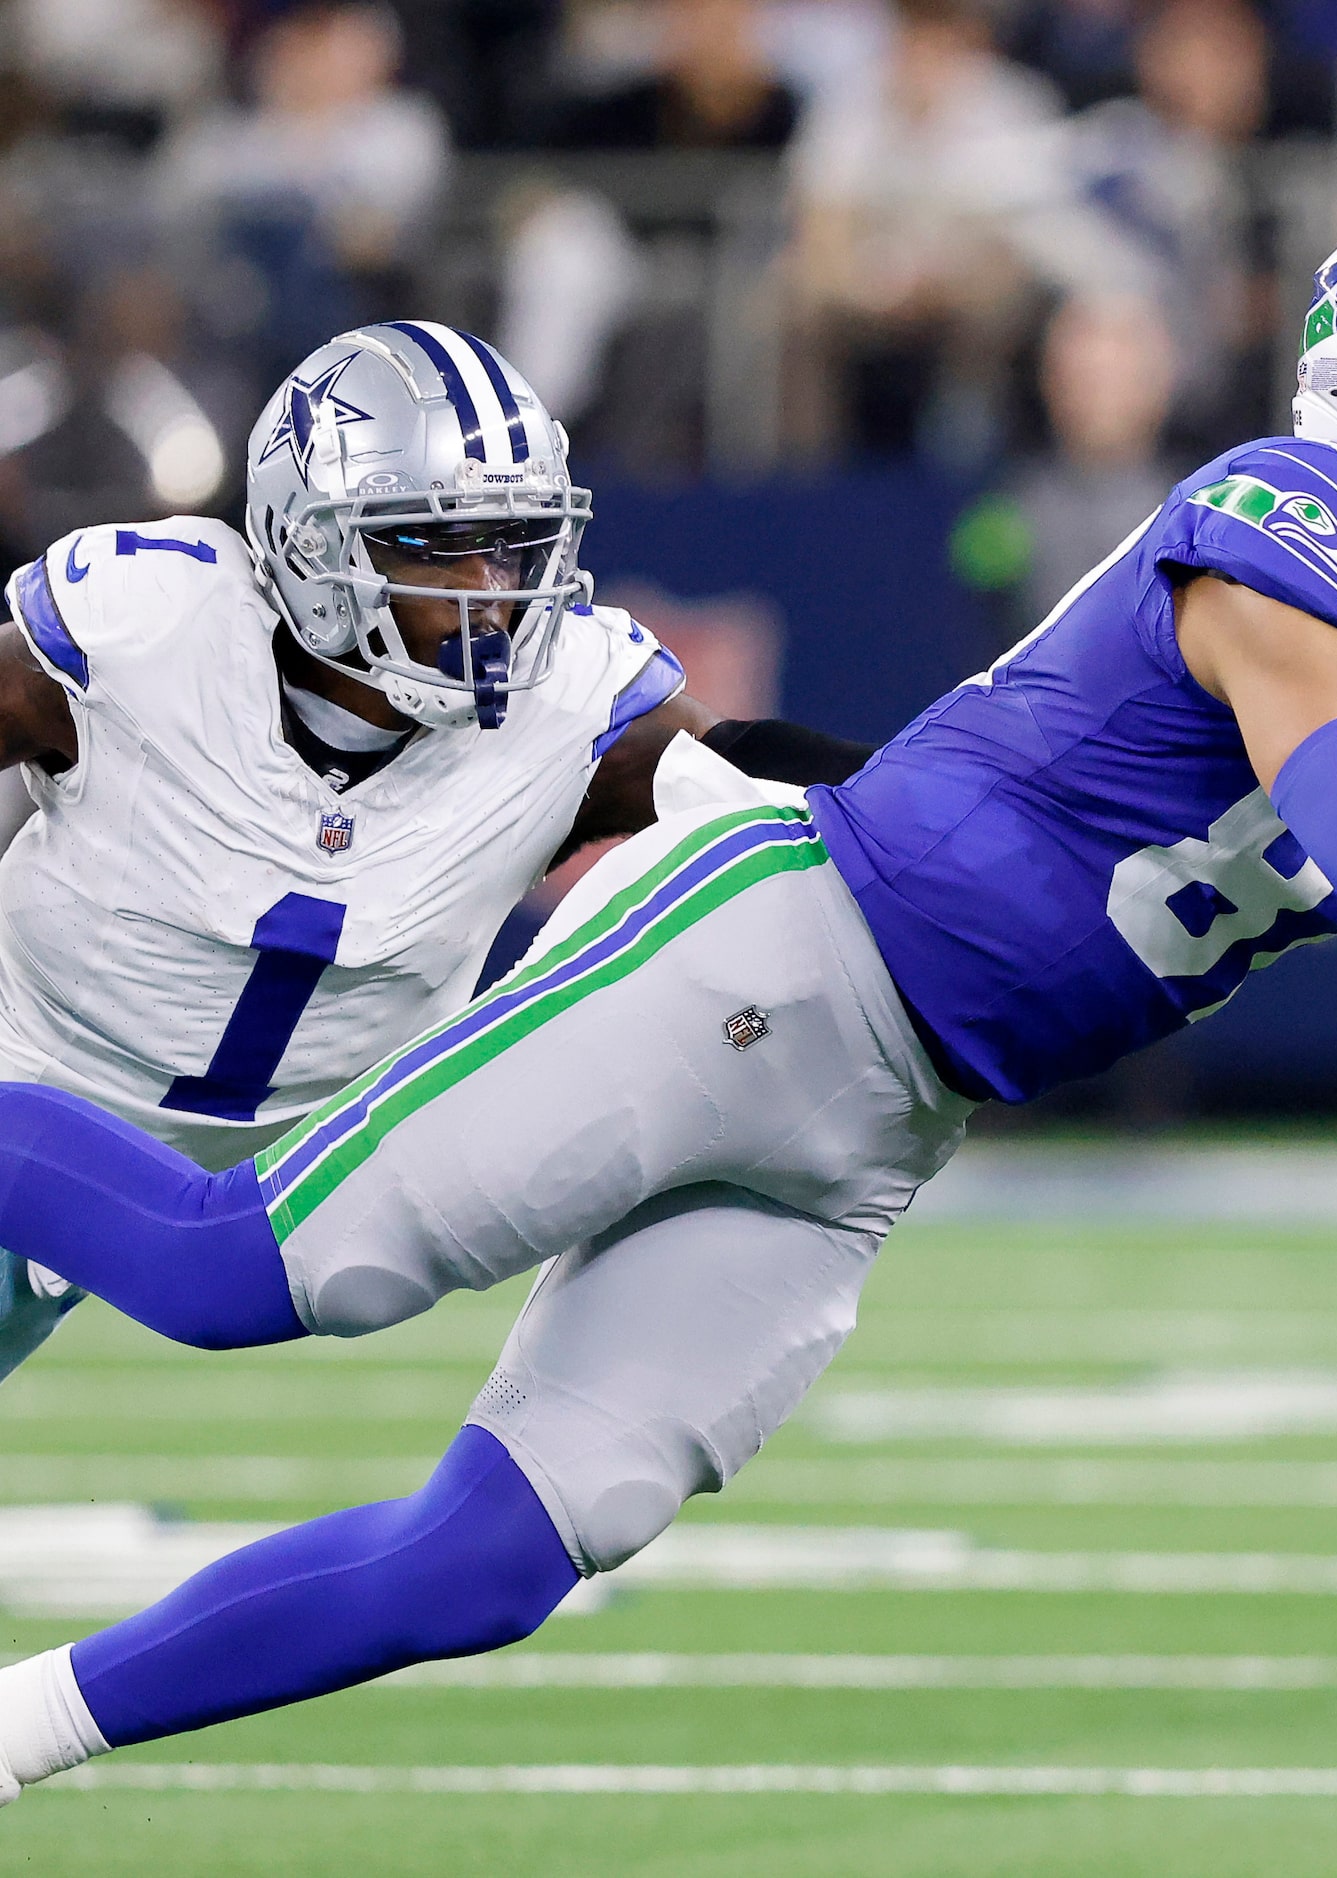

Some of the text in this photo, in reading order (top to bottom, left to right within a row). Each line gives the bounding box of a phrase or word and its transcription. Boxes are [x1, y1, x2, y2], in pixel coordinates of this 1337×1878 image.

[360, 485, 407, 495] OAKLEY
[115, 530, 217, 564] 1
[321, 828, 348, 849] NFL
[159, 892, 347, 1122] 1
[729, 1017, 752, 1045] NFL
